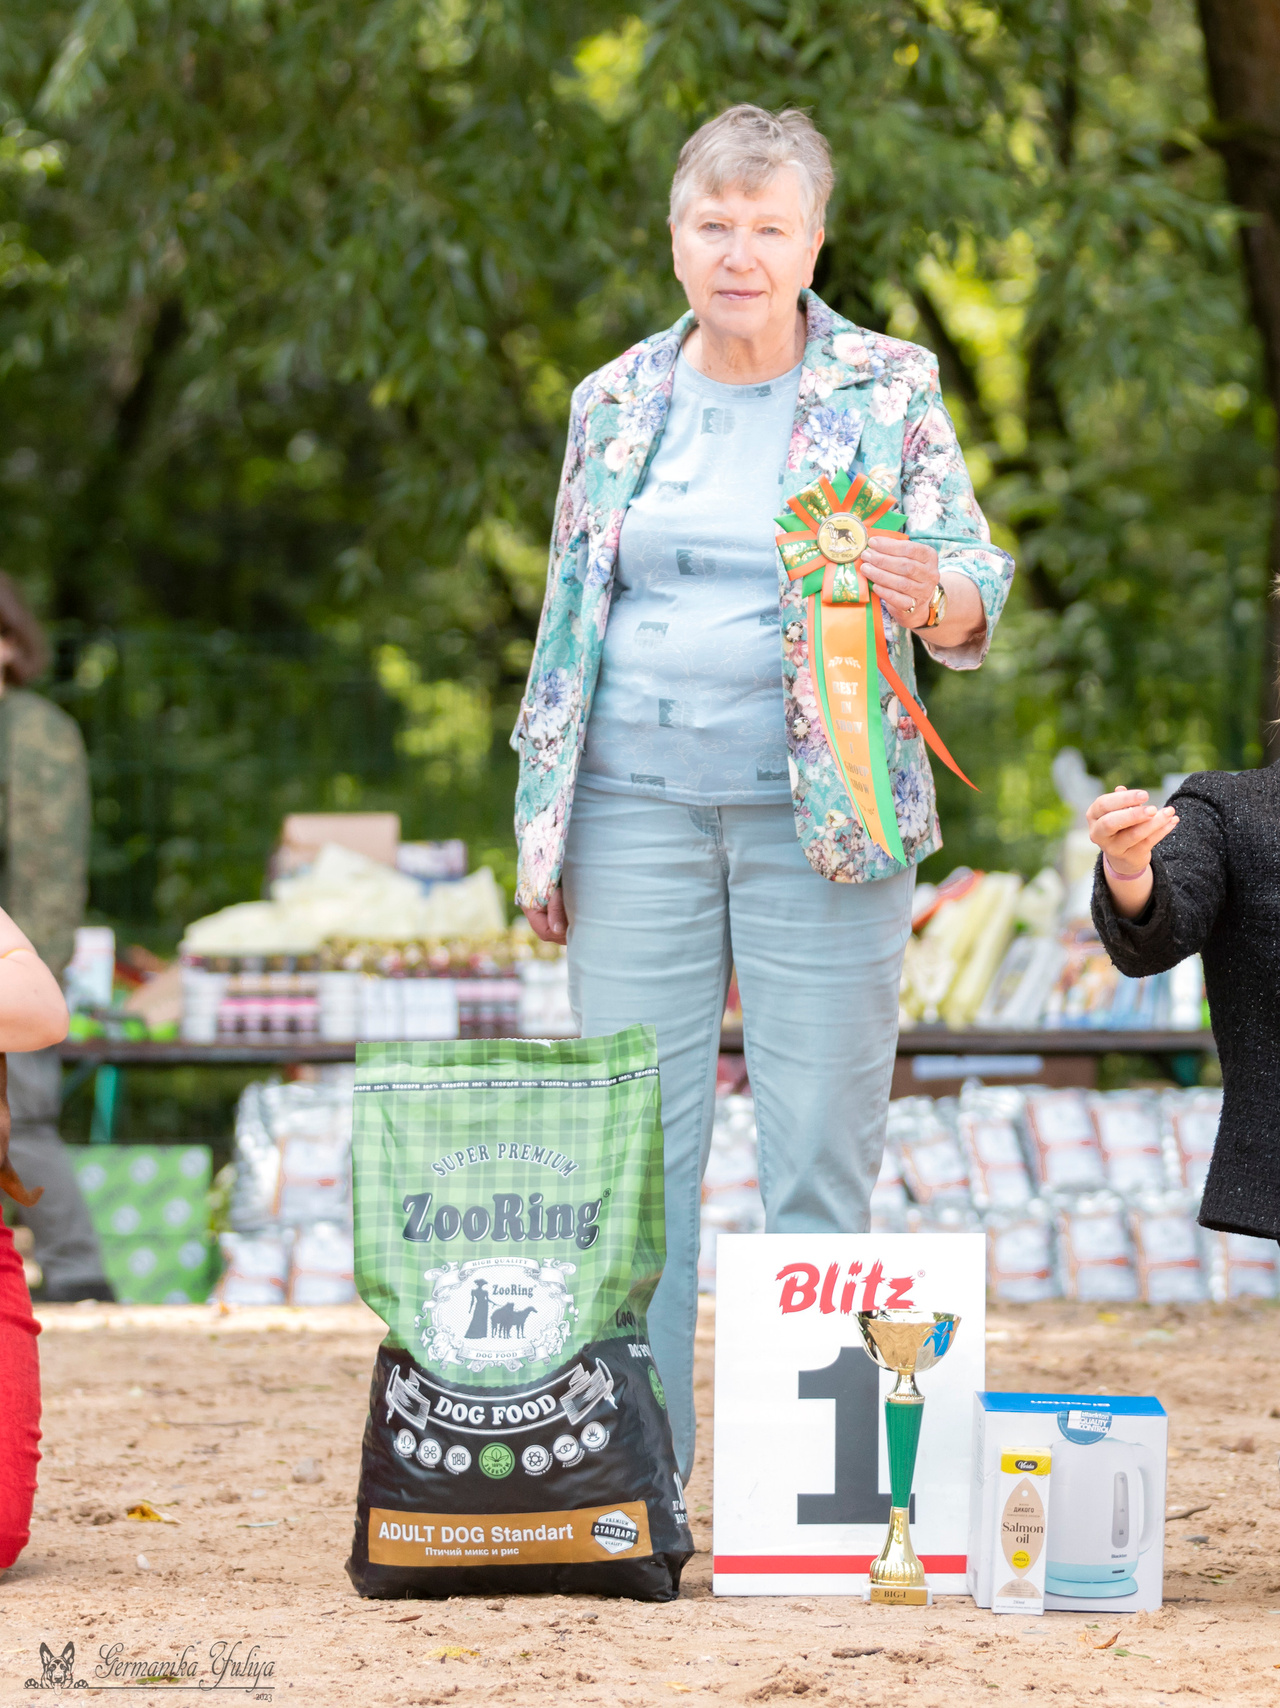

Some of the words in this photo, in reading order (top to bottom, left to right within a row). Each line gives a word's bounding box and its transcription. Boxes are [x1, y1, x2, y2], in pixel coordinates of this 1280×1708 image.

[832, 680, 859, 696] BEST
[841, 701, 852, 714] IN
[835, 719, 863, 734] SHOW
[843, 761, 869, 777] GROUP
[850, 778, 870, 795] SHOW
[431, 1143, 490, 1178] SUPER
[496, 1141, 579, 1178] PREMIUM
[402, 1191, 603, 1250] ZooRing
[471, 1259, 491, 1267] HIGH
[494, 1258, 528, 1266] QUALITY
[492, 1284, 534, 1299] ZooRing
[775, 1258, 917, 1315] Blitz
[434, 1395, 486, 1425] DOG
[491, 1394, 558, 1425] FOOD
[1079, 1418, 1107, 1427] QUALITY
[797, 1346, 916, 1525] 1
[605, 1517, 629, 1526] PREMIUM
[1002, 1521, 1044, 1534] Salmon
[379, 1521, 436, 1542] ADULT
[441, 1526, 485, 1543] DOG
[491, 1523, 574, 1543] Standart
[594, 1525, 637, 1541] СТАНДАРТ
[1015, 1534, 1030, 1544] oil
[425, 1546, 462, 1556] Птичий
[464, 1548, 489, 1556] микс
[500, 1547, 519, 1557] рис
